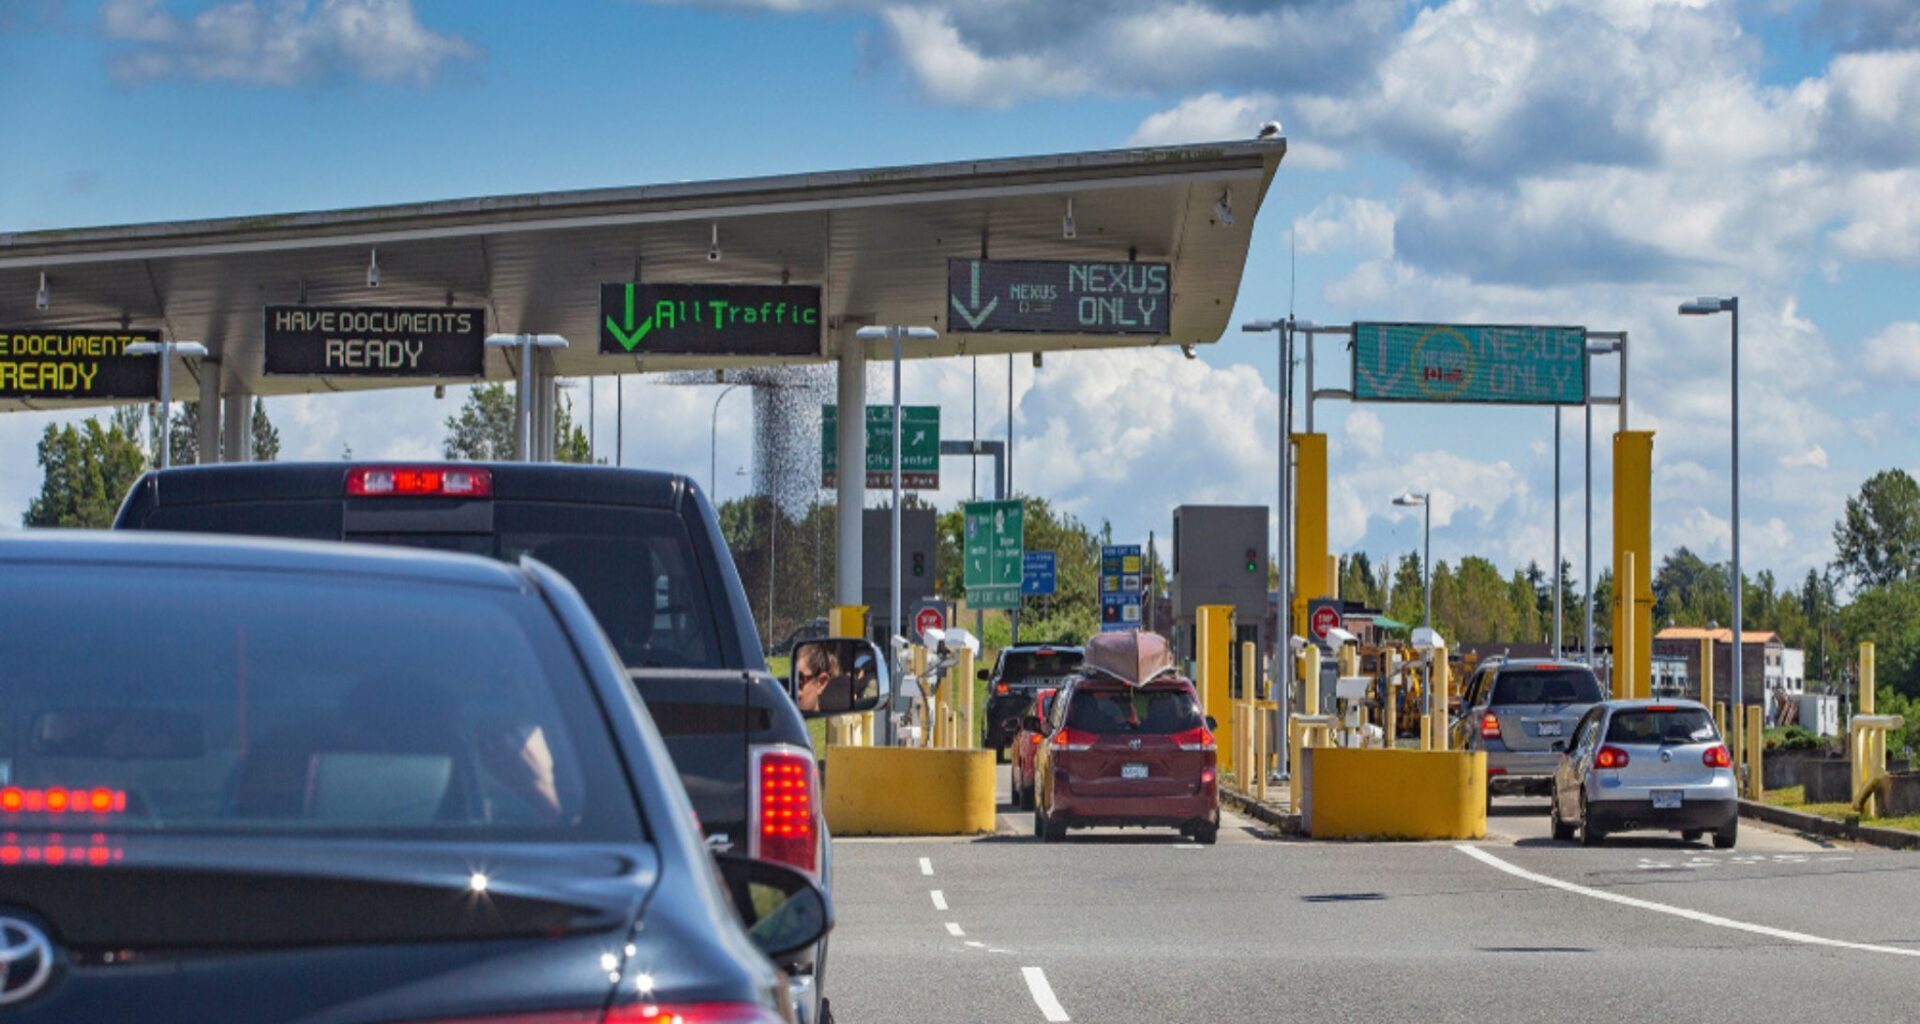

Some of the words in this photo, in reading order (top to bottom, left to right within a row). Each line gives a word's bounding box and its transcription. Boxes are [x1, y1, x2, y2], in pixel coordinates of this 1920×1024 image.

[1010, 284, 1058, 300] NEXUS
[1068, 264, 1167, 294] NEXUS
[275, 311, 335, 332] HAVE
[339, 312, 472, 334] DOCUMENTS
[655, 300, 702, 329] All
[708, 300, 817, 329] Traffic
[1078, 296, 1157, 326] ONLY
[325, 339, 424, 369] READY
[1479, 327, 1580, 361] NEXUS
[0, 361, 98, 391] READY
[1489, 364, 1573, 394] ONLY
